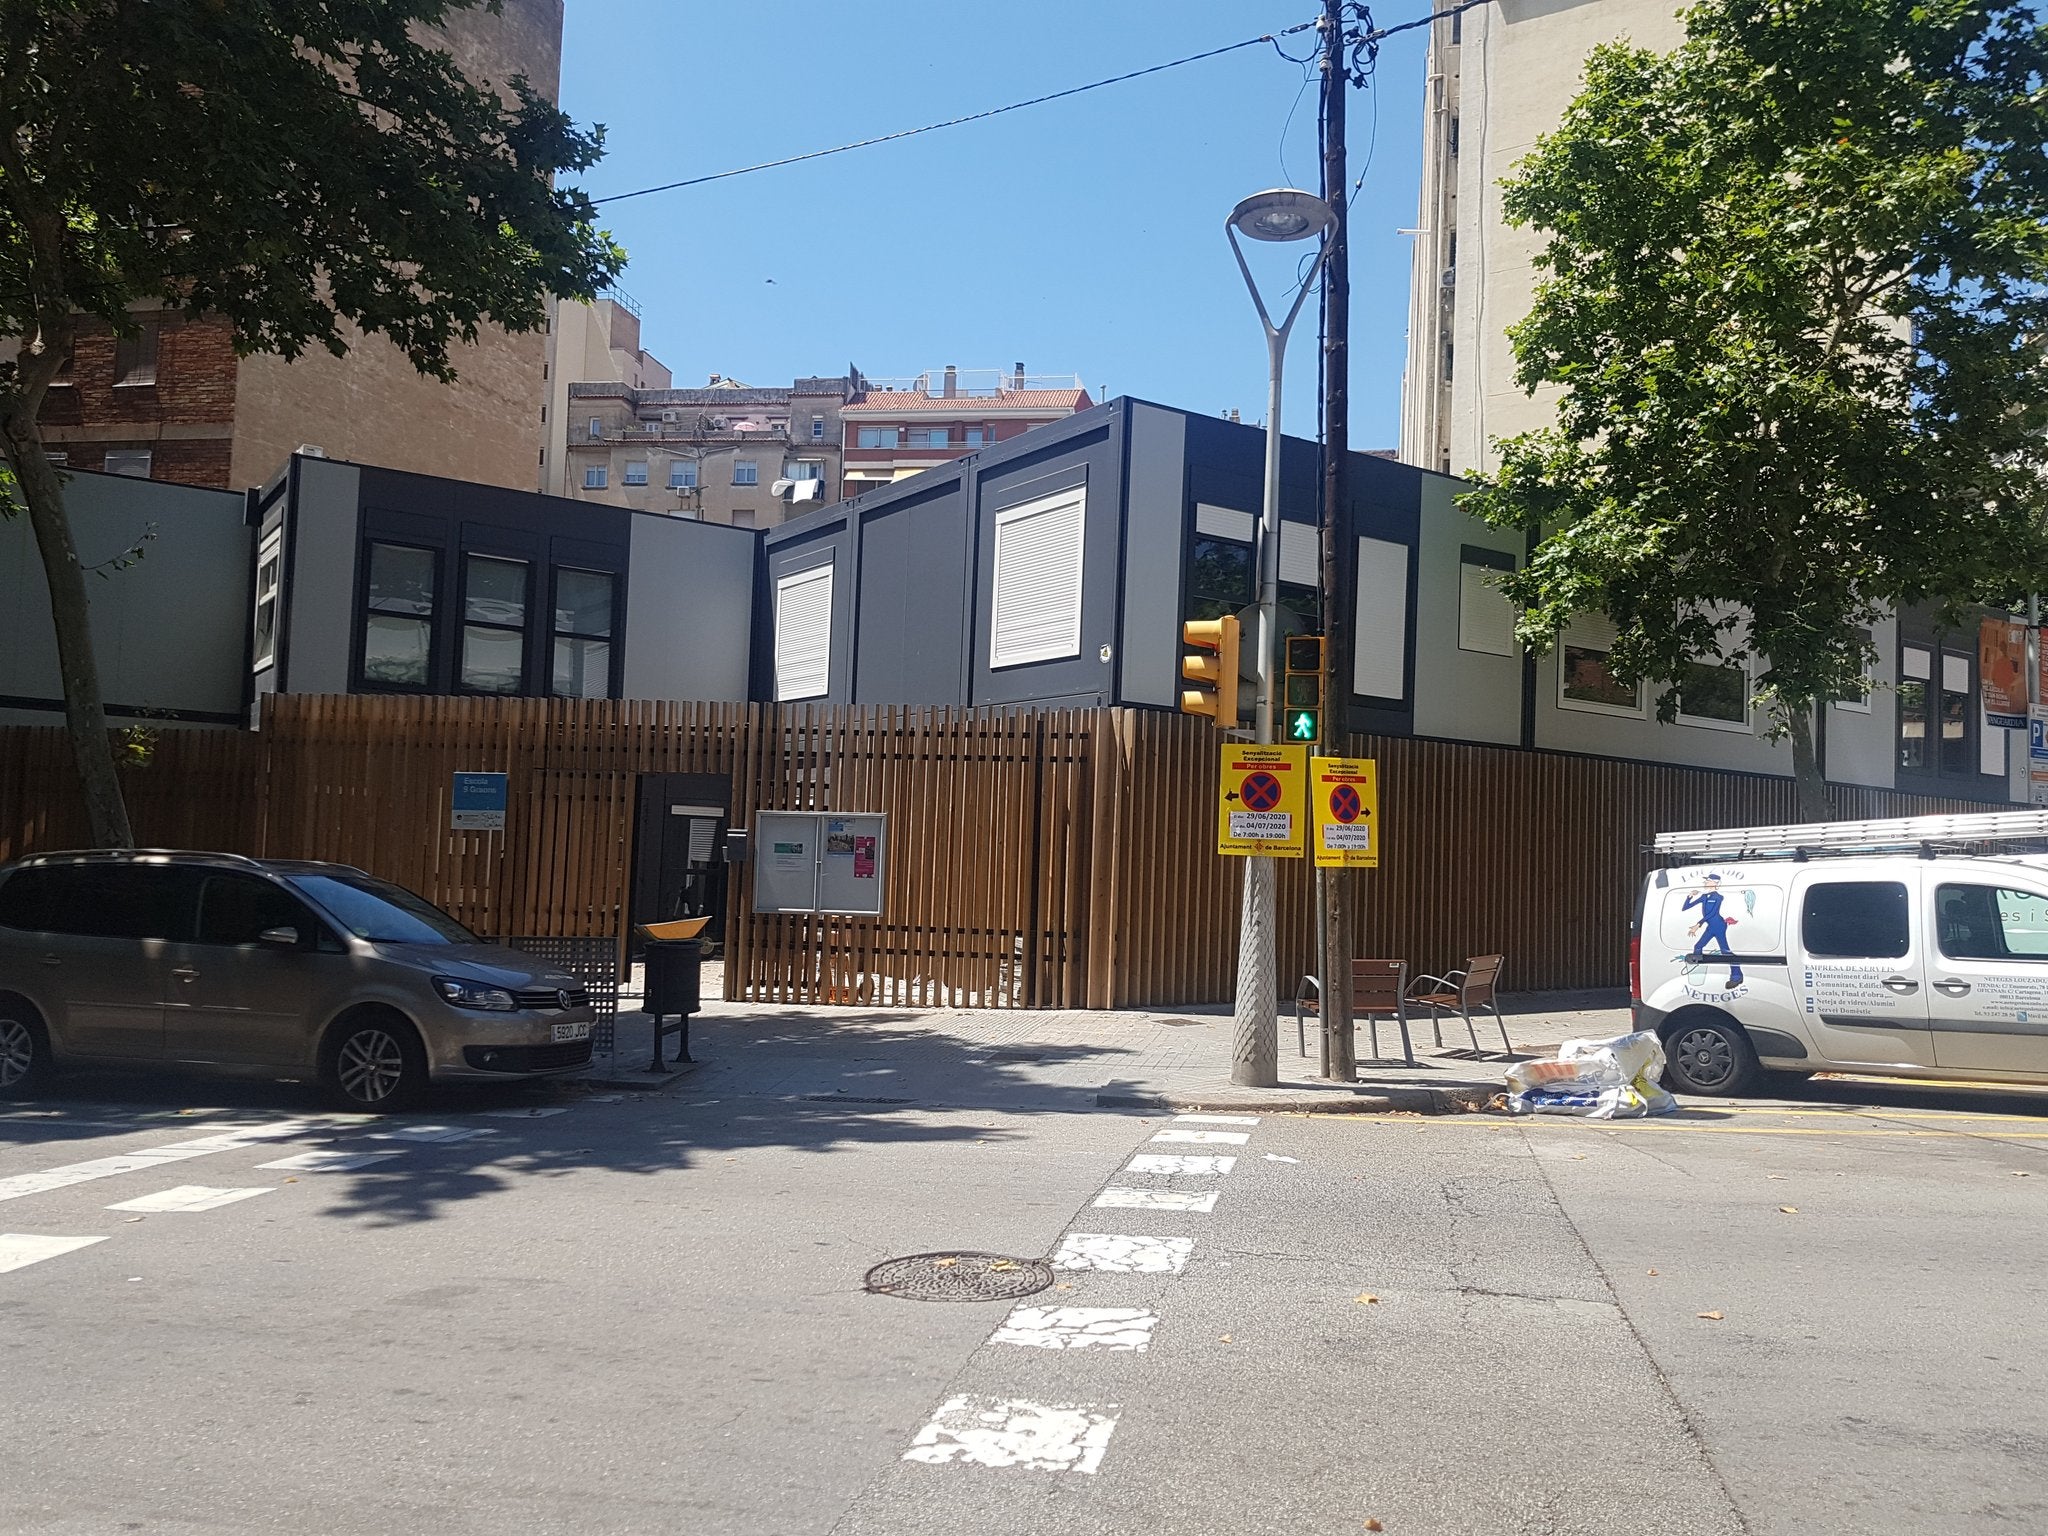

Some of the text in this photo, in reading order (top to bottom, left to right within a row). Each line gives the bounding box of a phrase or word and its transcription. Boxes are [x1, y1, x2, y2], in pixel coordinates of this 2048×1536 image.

[2033, 723, 2040, 744] P
[464, 777, 488, 785] Escola
[1805, 964, 1844, 972] EMPRESA
[1815, 981, 1857, 989] Comunitats,
[1681, 984, 1749, 1003] NETEGES
[557, 1025, 573, 1039] 5920
